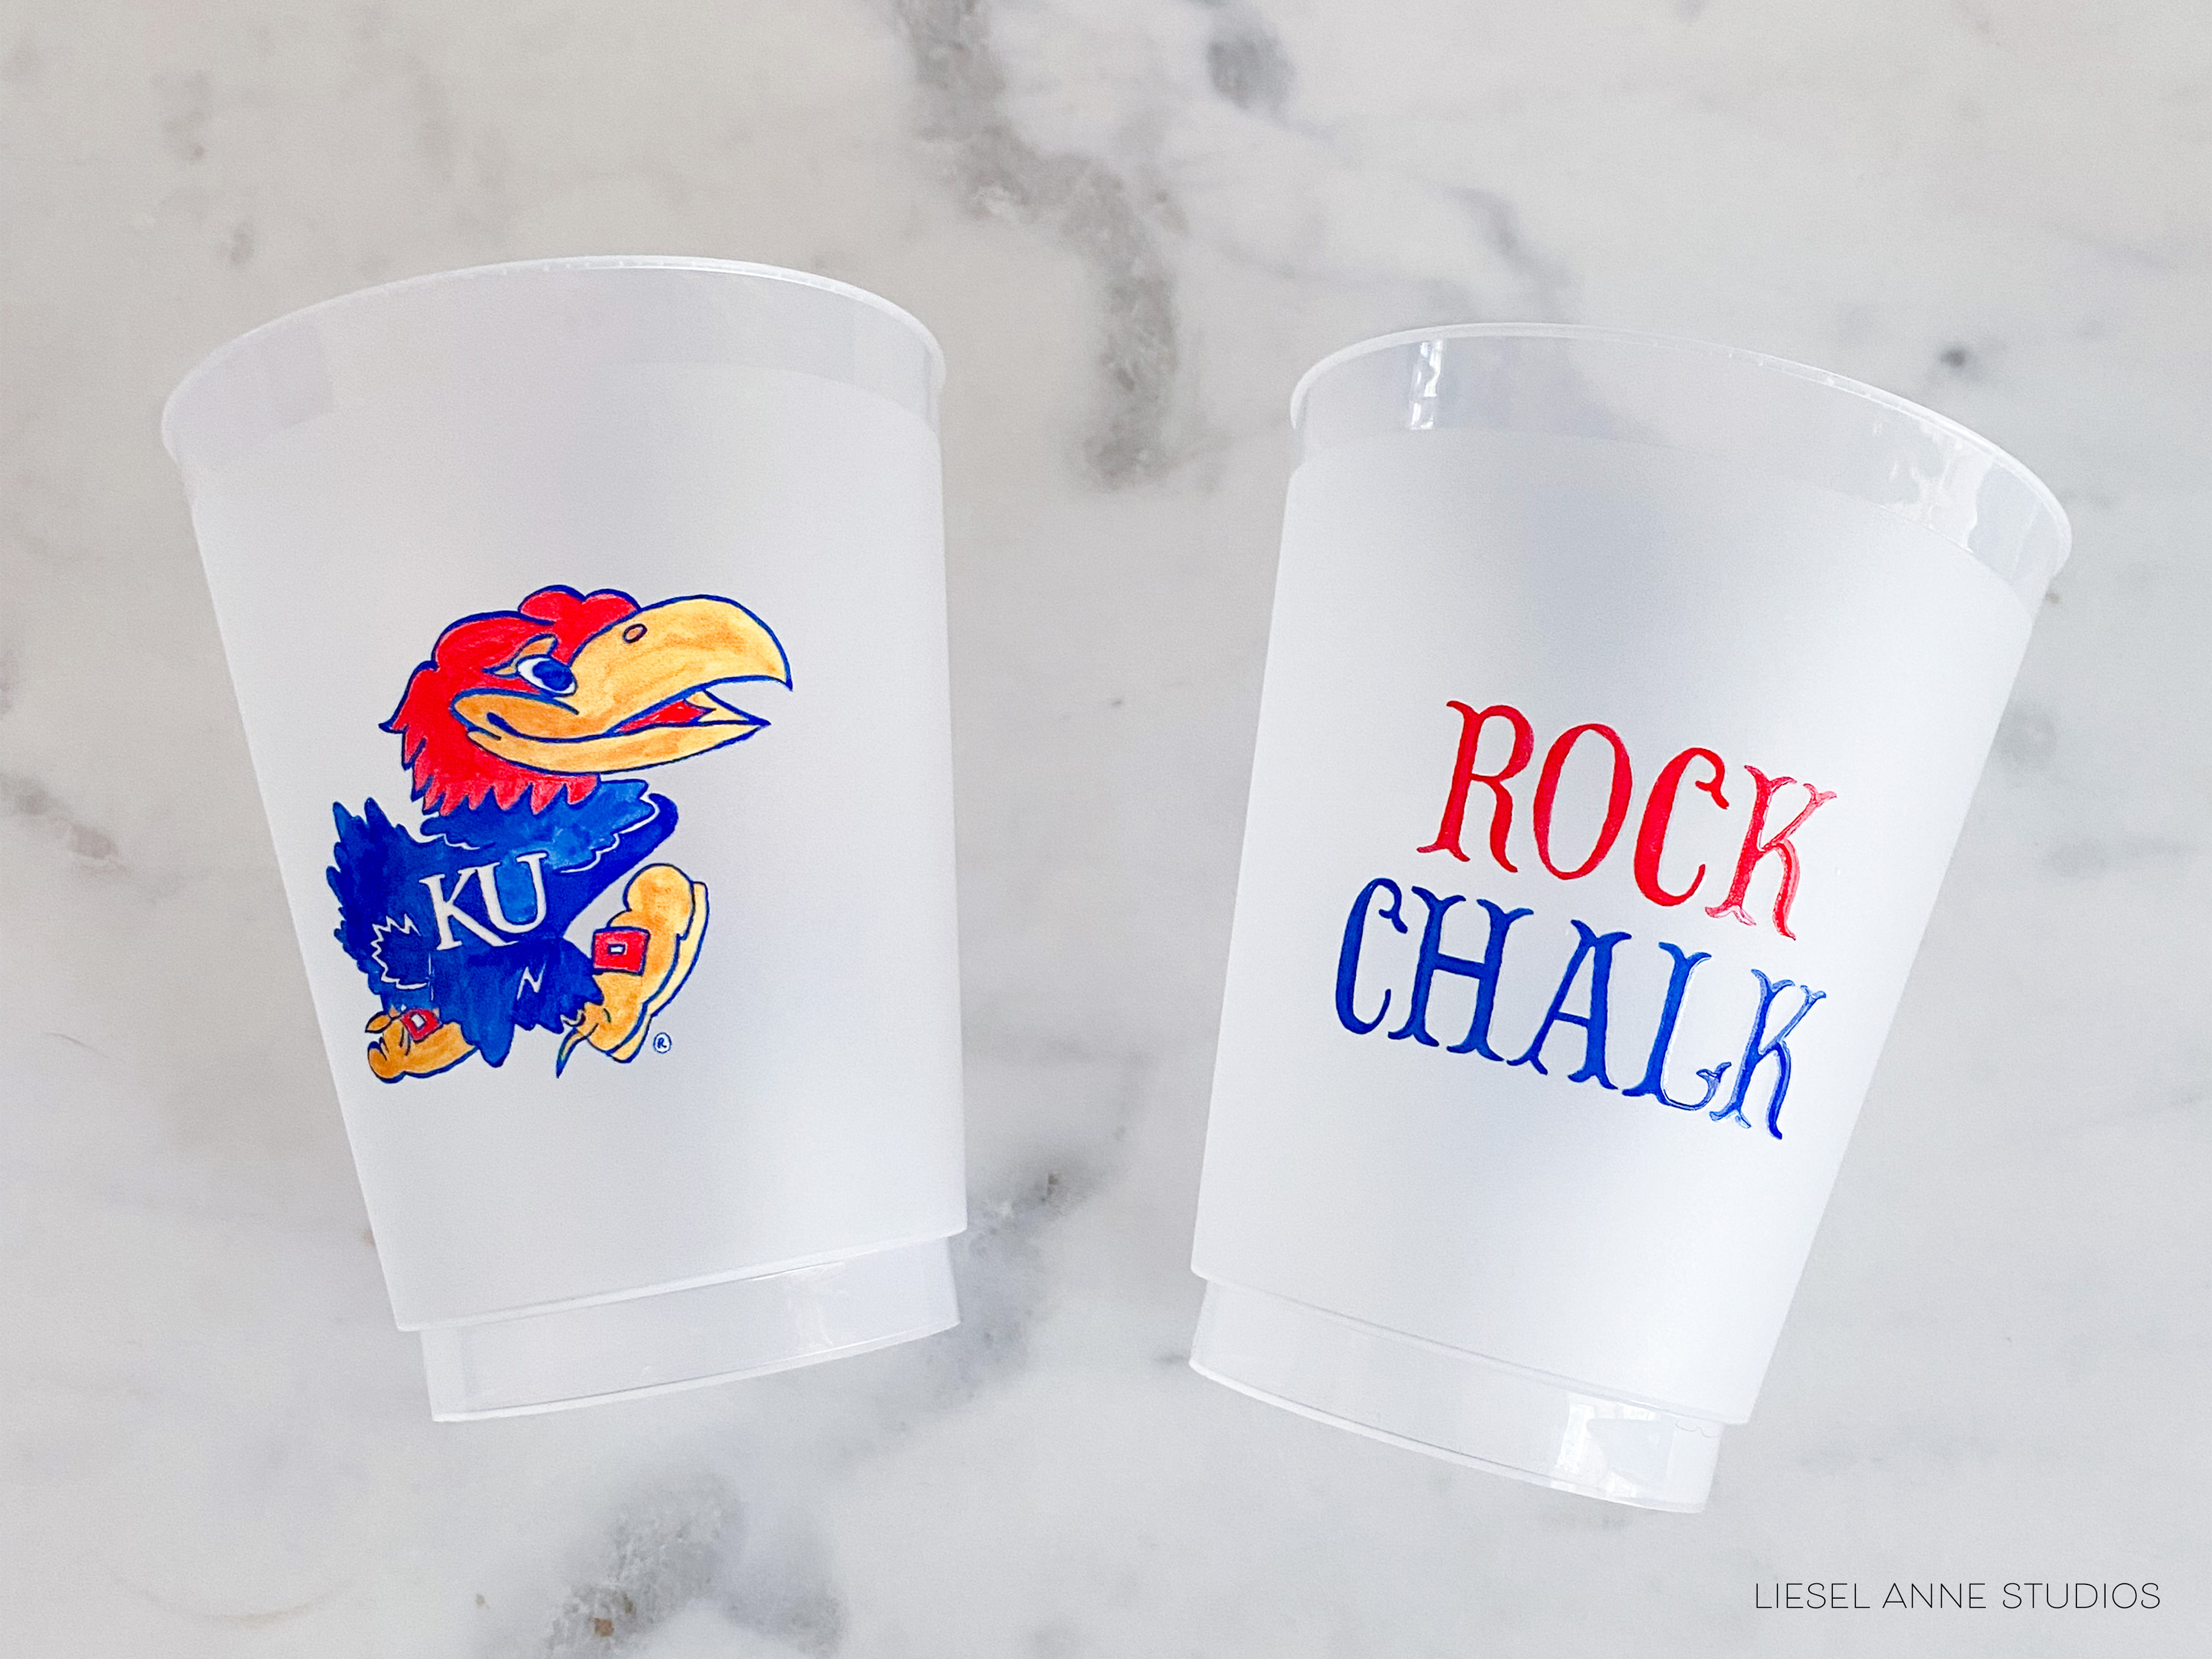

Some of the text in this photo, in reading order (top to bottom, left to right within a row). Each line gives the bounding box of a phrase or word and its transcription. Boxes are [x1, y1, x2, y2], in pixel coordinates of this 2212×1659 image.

[419, 852, 547, 951] KU
[1416, 700, 1838, 942] ROCK
[1335, 877, 1827, 1140] CHALK
